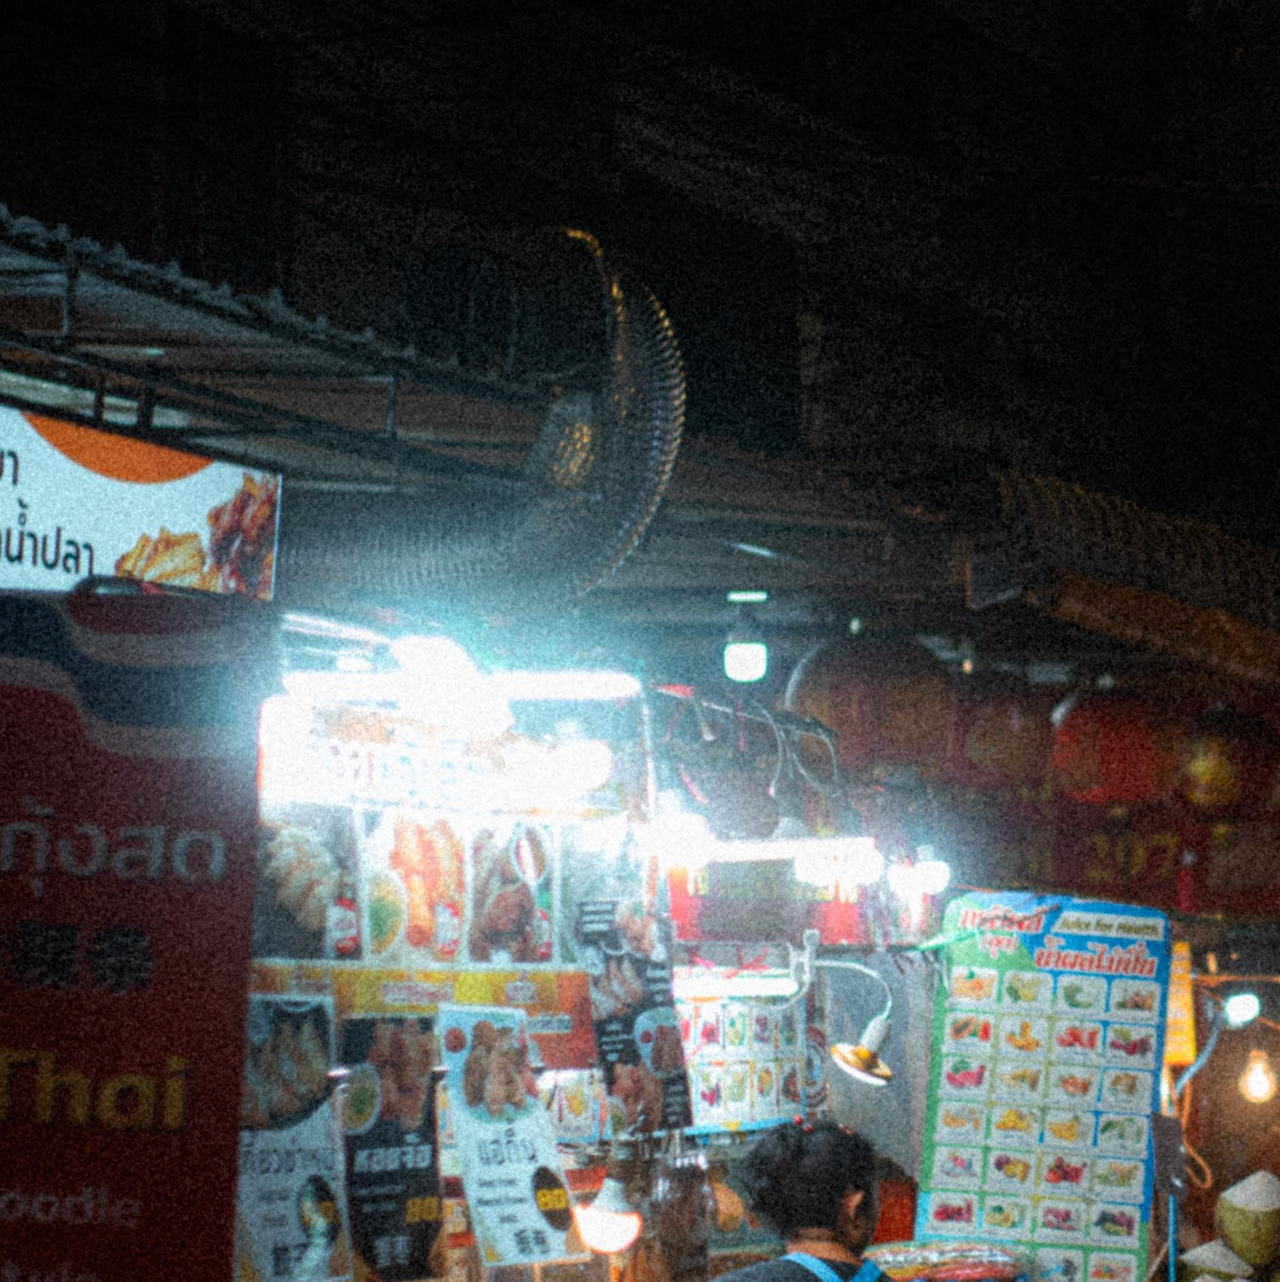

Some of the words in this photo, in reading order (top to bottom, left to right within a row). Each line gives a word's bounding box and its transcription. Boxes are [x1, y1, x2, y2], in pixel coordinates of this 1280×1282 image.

[0, 498, 95, 577] น้ำปลา
[0, 1048, 188, 1131] Thai
[0, 1186, 143, 1229] oodle
